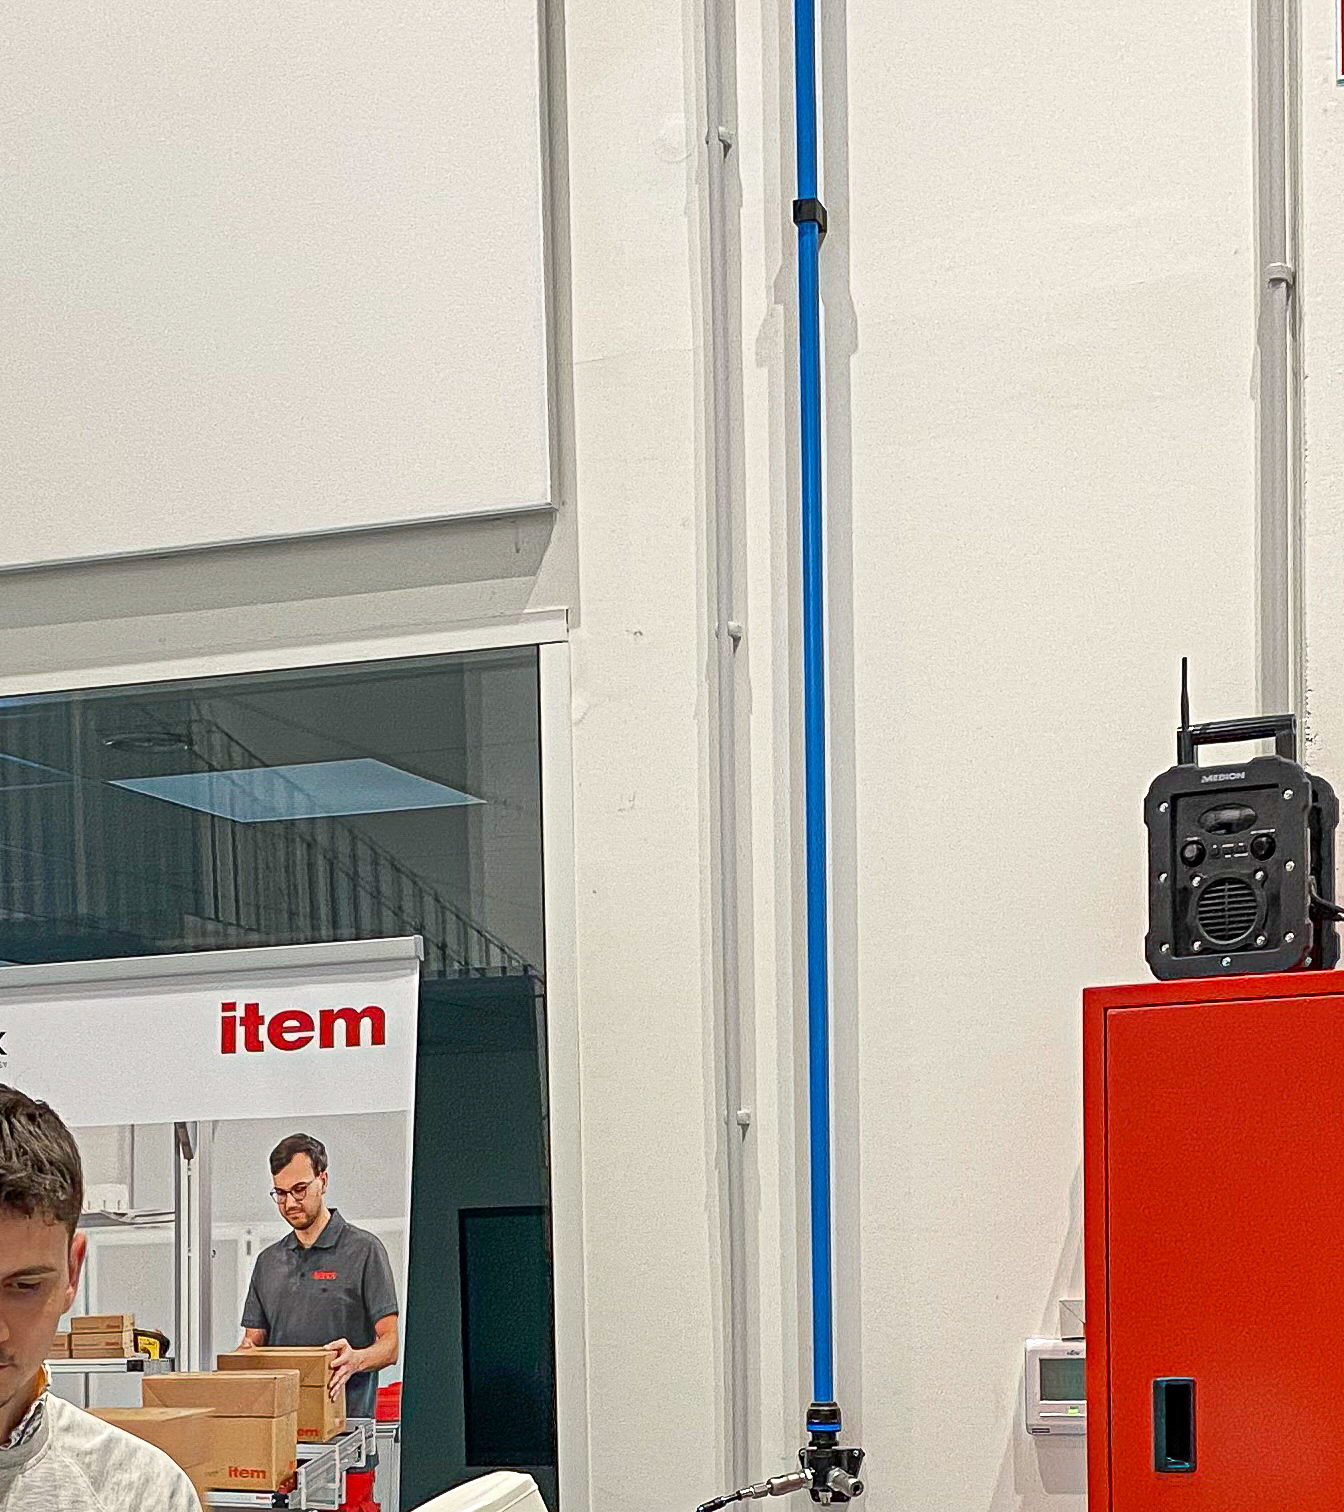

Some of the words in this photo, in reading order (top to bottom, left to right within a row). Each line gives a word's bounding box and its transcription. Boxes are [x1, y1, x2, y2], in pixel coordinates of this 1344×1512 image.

[1200, 771, 1246, 784] MEDION
[221, 1002, 387, 1054] item
[227, 1465, 267, 1480] item
